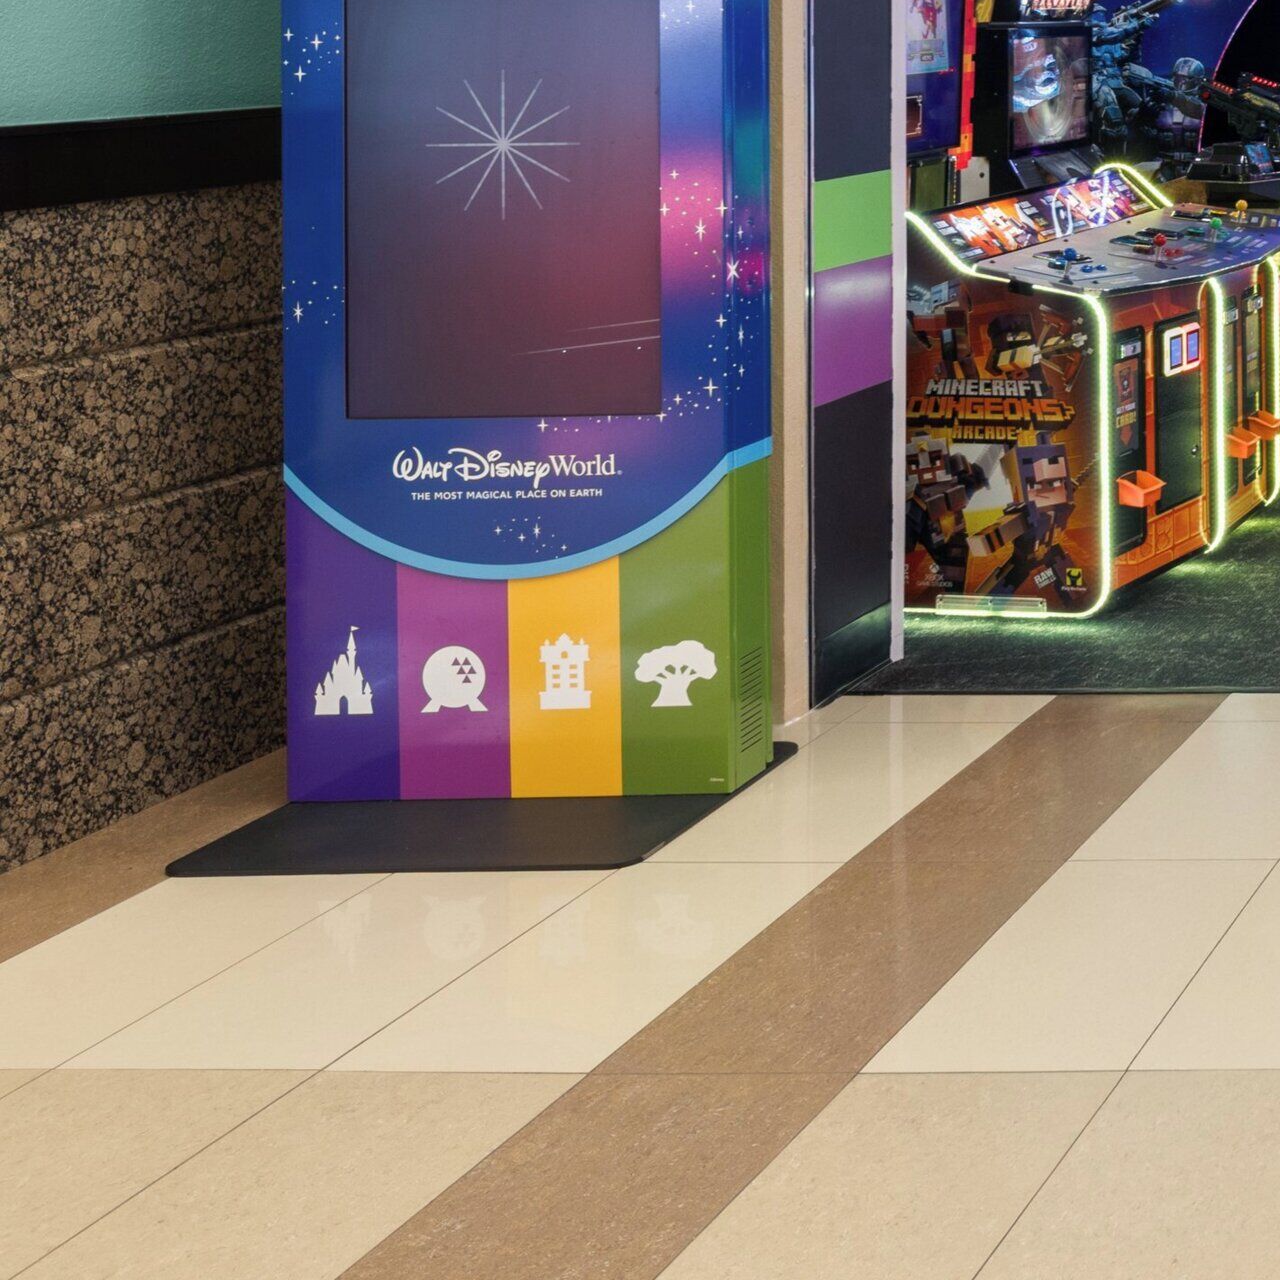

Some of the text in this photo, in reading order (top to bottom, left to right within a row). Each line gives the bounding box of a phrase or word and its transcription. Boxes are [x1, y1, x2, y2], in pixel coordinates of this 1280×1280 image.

[925, 378, 1043, 397] MINECRAFT
[906, 396, 1076, 422] DUNGEONS
[951, 423, 1018, 440] ARCADE
[549, 453, 617, 477] World
[411, 488, 603, 500] THE MOST MAGICAL PLACE ON EARTH
